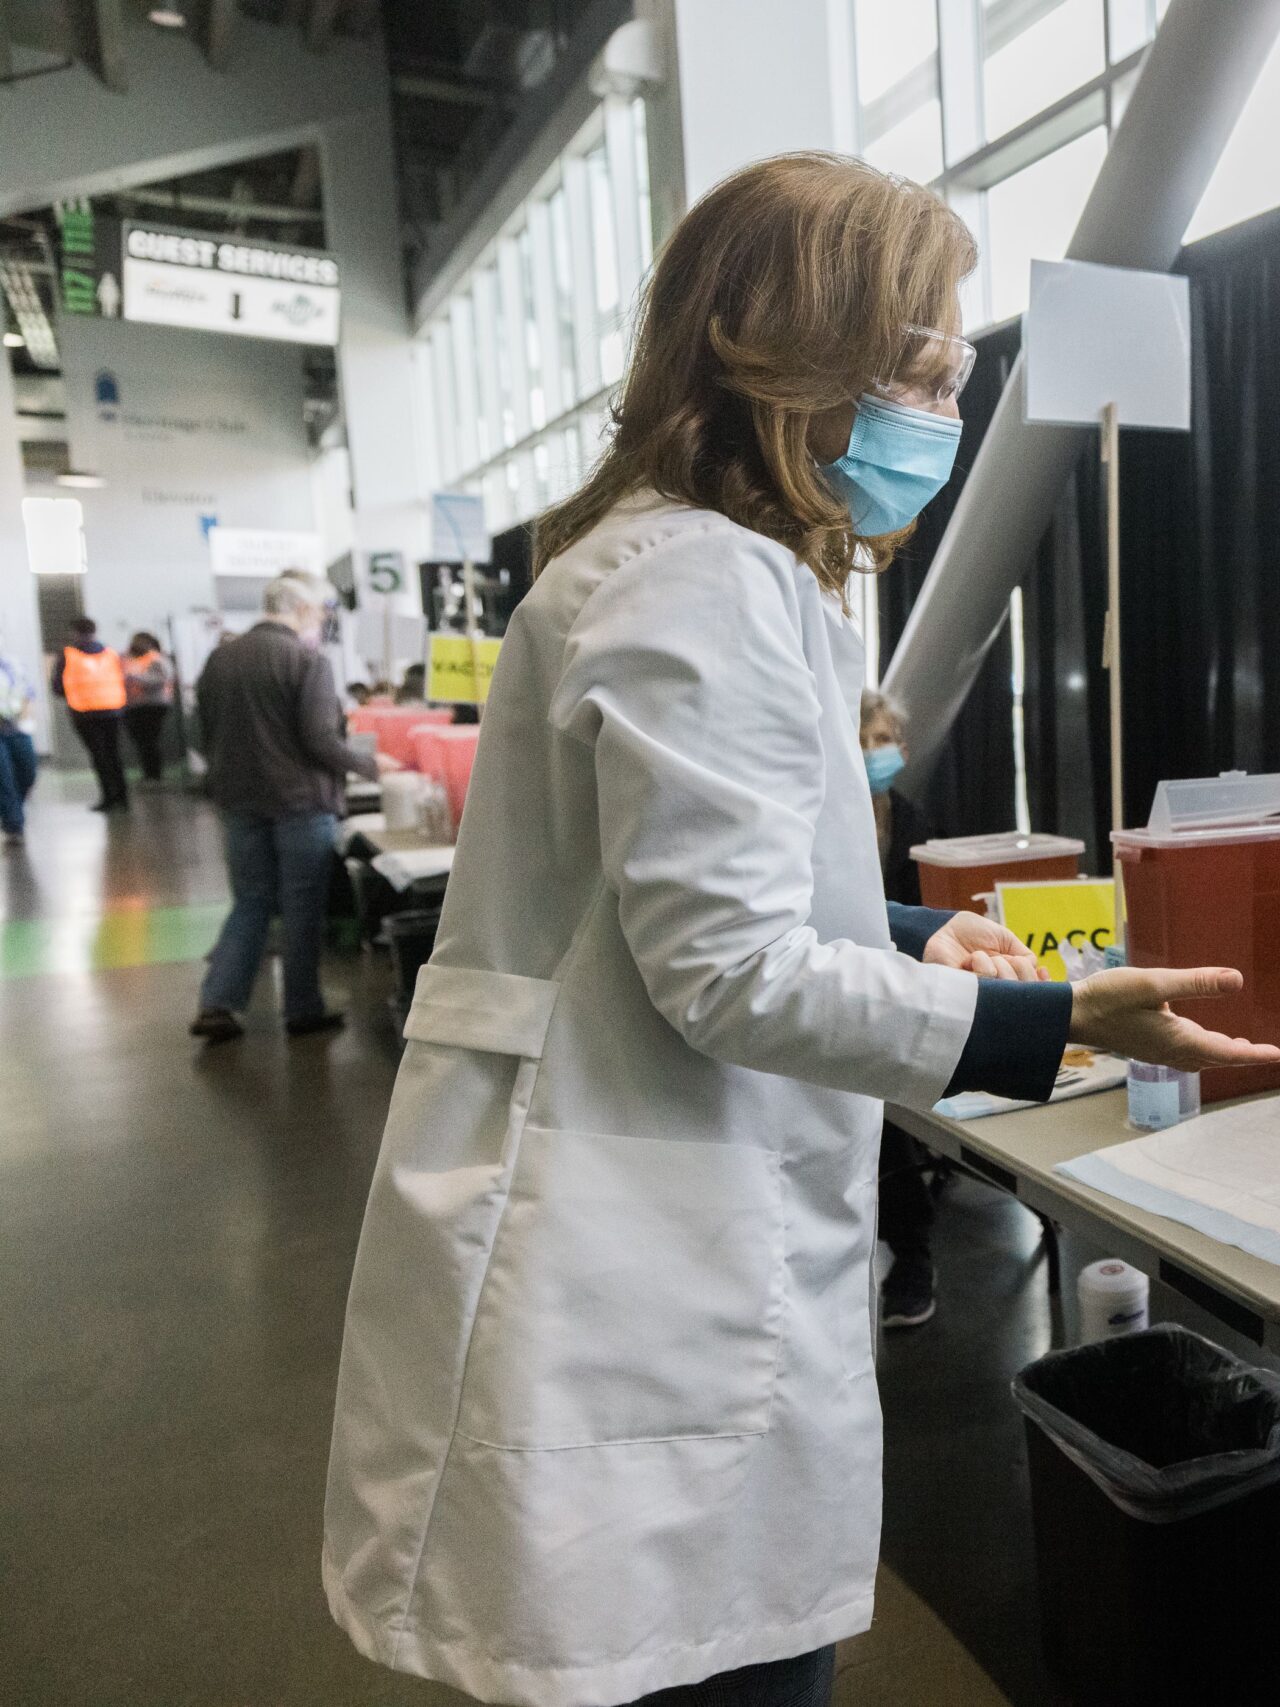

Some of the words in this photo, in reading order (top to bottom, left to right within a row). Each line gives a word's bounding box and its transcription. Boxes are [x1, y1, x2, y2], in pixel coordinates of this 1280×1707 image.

[127, 230, 217, 269] GUEST
[217, 243, 339, 286] SERVICES
[369, 553, 401, 593] 5
